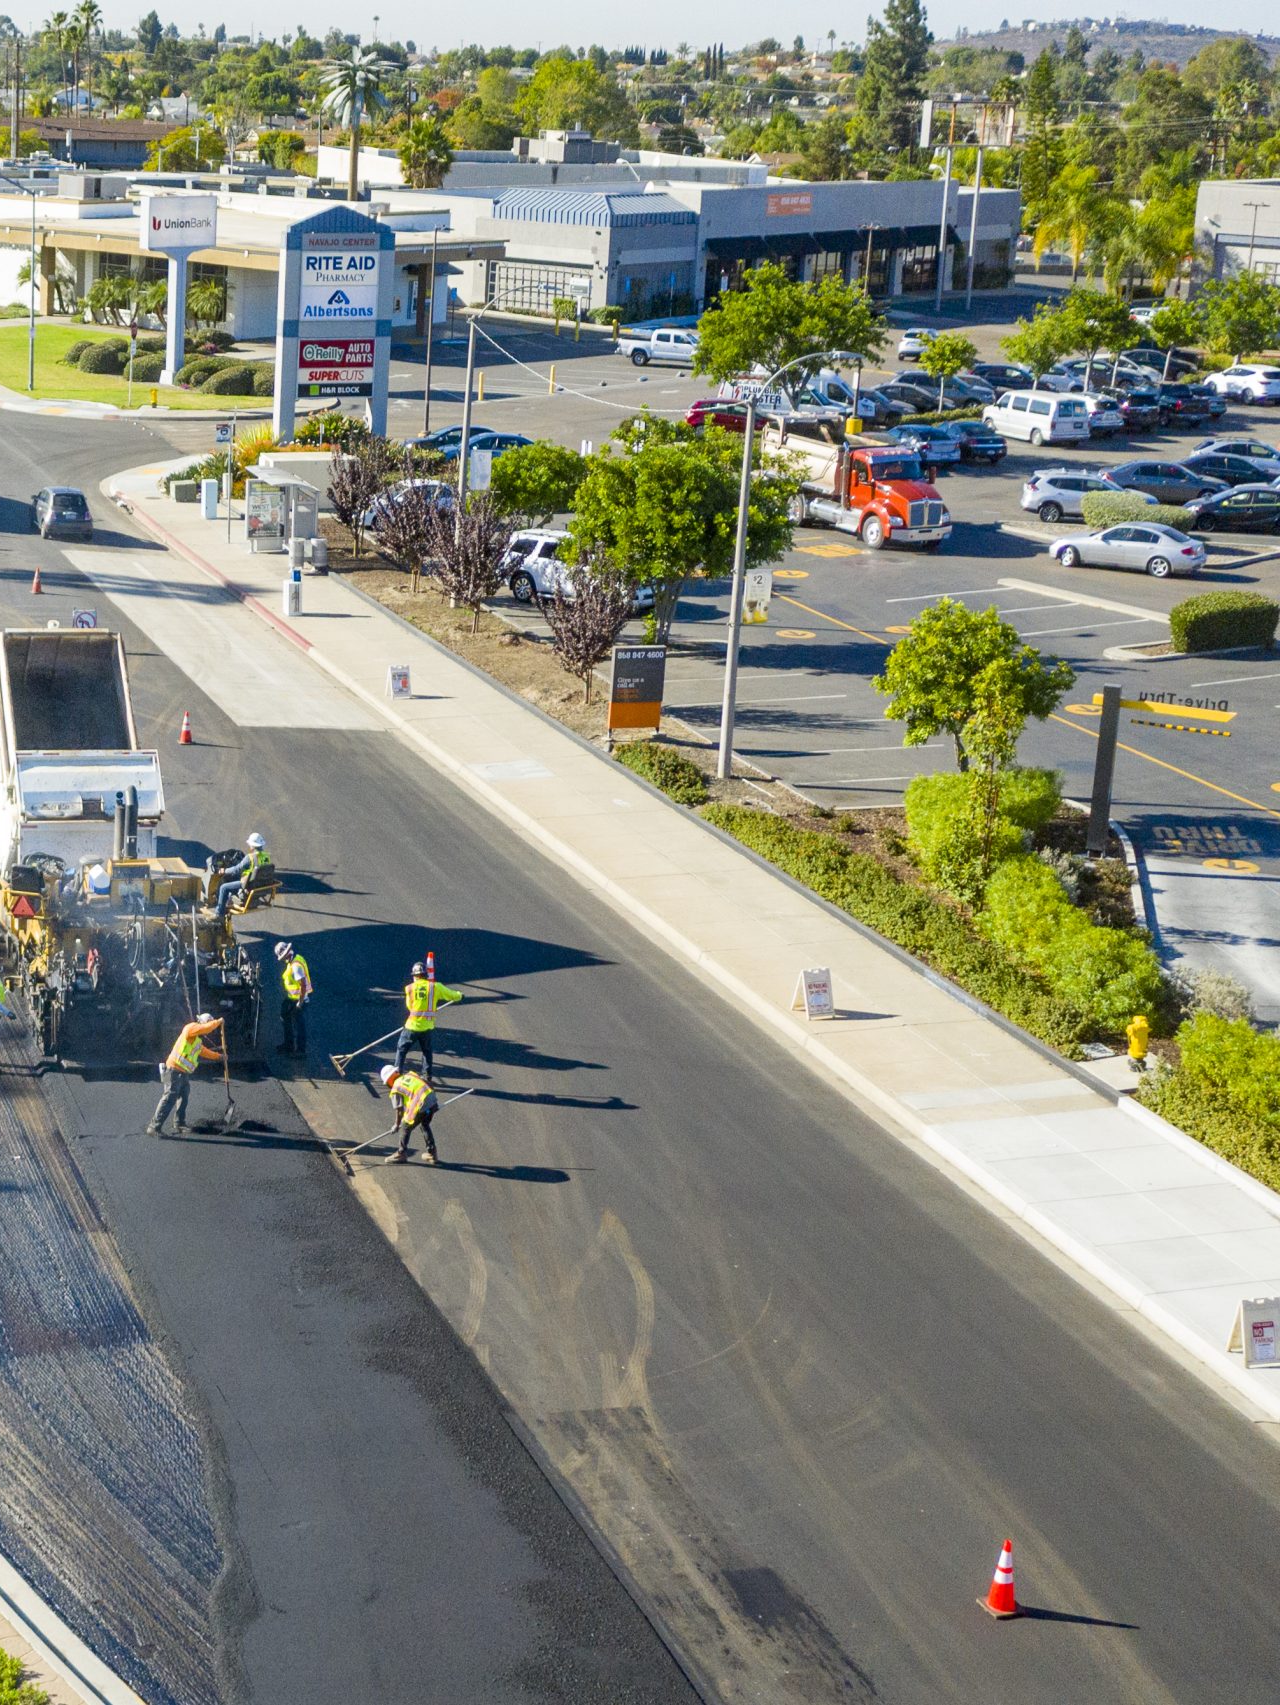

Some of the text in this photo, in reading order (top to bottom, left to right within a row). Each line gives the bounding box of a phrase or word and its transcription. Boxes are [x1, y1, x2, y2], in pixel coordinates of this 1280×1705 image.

[164, 217, 212, 229] UnionBank
[308, 238, 376, 247] NAVAJO CENTER
[306, 256, 376, 270] RITE AID
[303, 304, 374, 318] Albertsons
[303, 343, 371, 362] O'Reilly AUTO
[345, 353, 373, 363] PARTS
[308, 370, 365, 382] SUPERCUTS
[1152, 825, 1249, 840] THRU
[1254, 1328, 1263, 1336] NO
